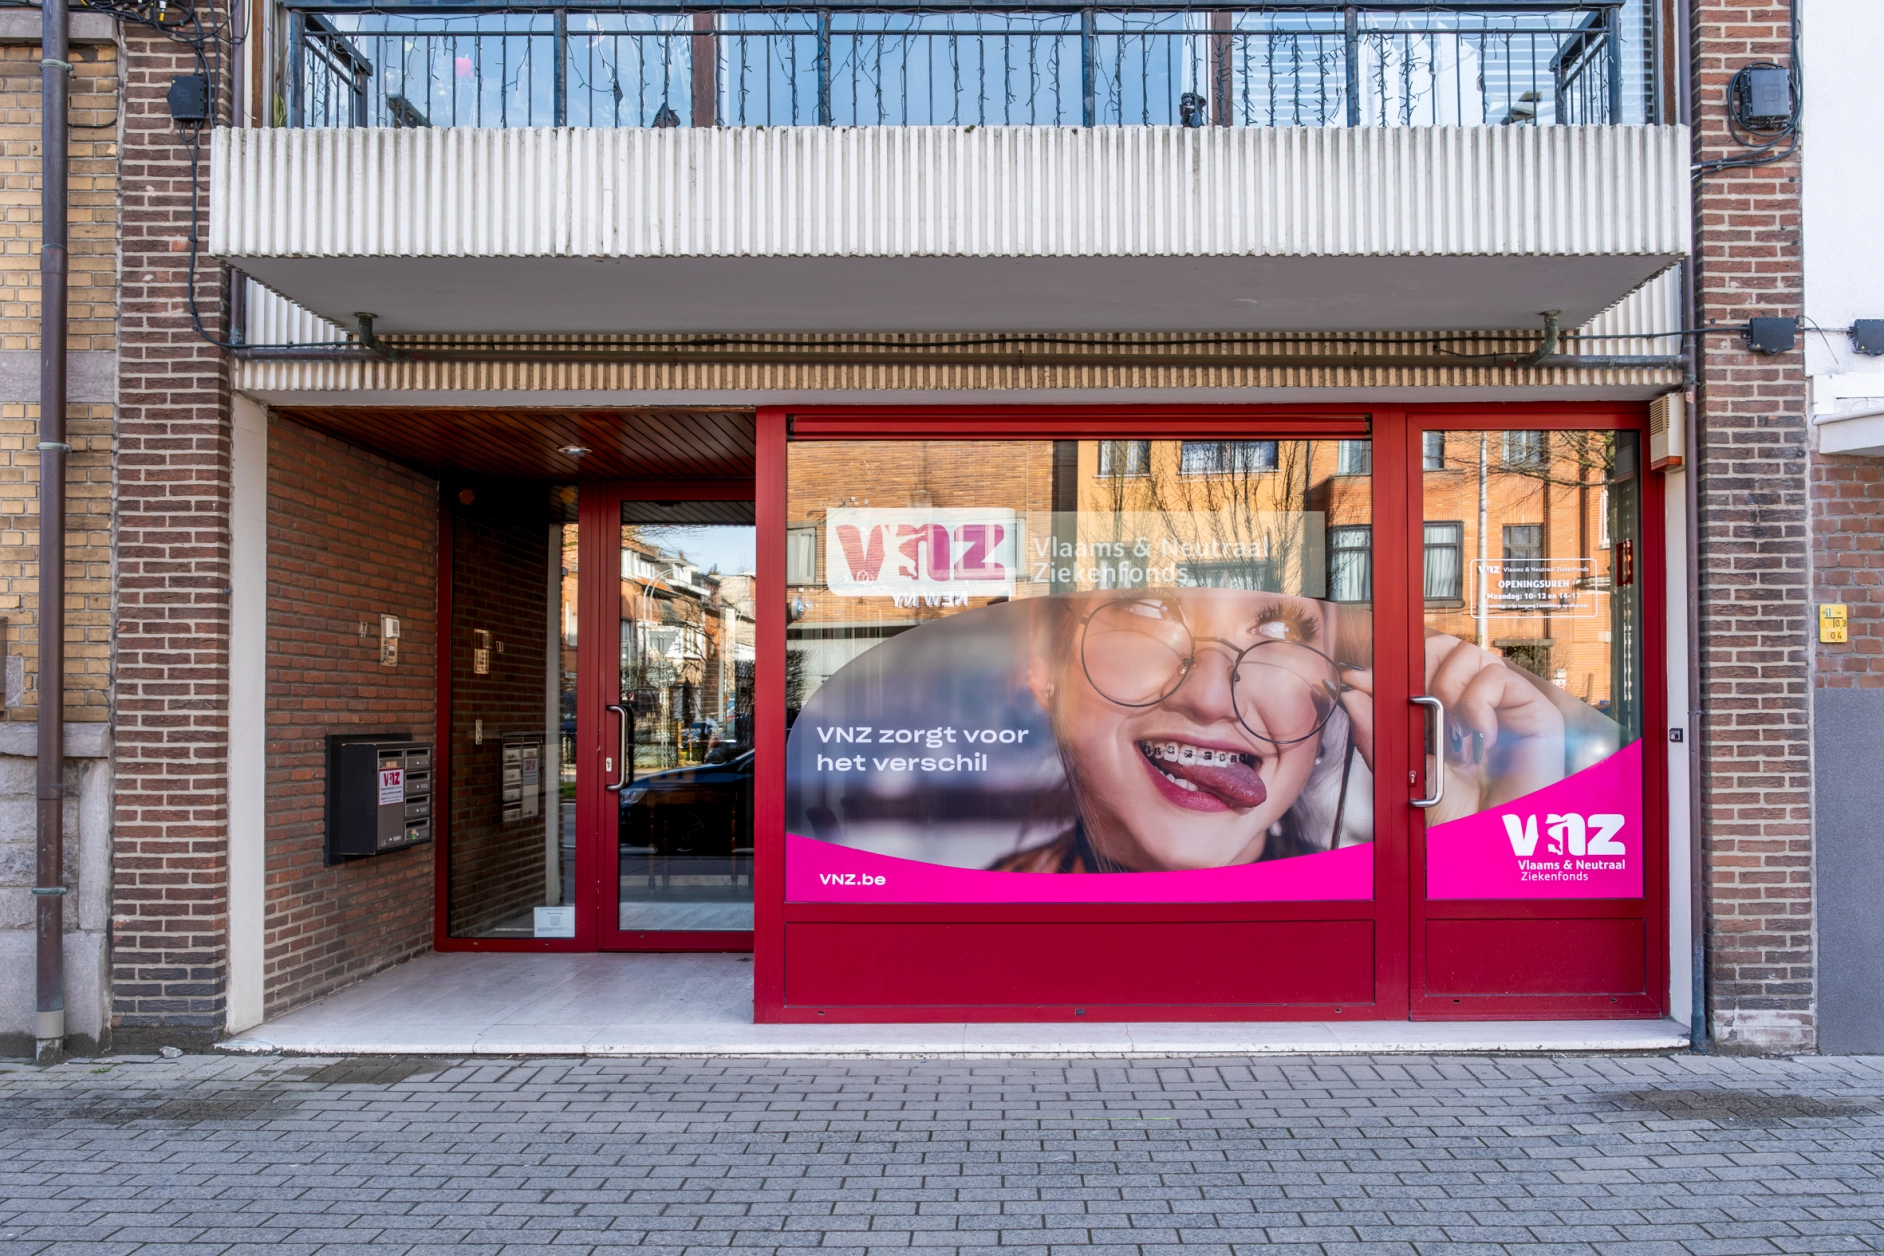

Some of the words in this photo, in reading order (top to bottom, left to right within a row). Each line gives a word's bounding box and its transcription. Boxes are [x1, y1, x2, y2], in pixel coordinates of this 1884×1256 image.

[1033, 536, 1125, 558] Vlaams
[1136, 537, 1152, 558] &
[1161, 535, 1269, 558] Neutraal
[1033, 561, 1189, 584] Ziekenfonds
[1498, 580, 1569, 588] OPENINGSUREN
[1486, 592, 1523, 602] Maandag:
[1524, 592, 1547, 600] 10-13
[1559, 592, 1581, 600] 14-17
[816, 727, 872, 743] VNZ
[878, 727, 957, 748] zorgt
[963, 729, 1029, 743] voor
[817, 754, 866, 771] het
[872, 752, 988, 771] verschil
[1518, 860, 1560, 870] Vlaams
[1563, 860, 1573, 870] &
[1576, 859, 1626, 870] Neutraal
[819, 873, 886, 886] VNZ.be
[1520, 871, 1589, 881] Ziekenfonds
